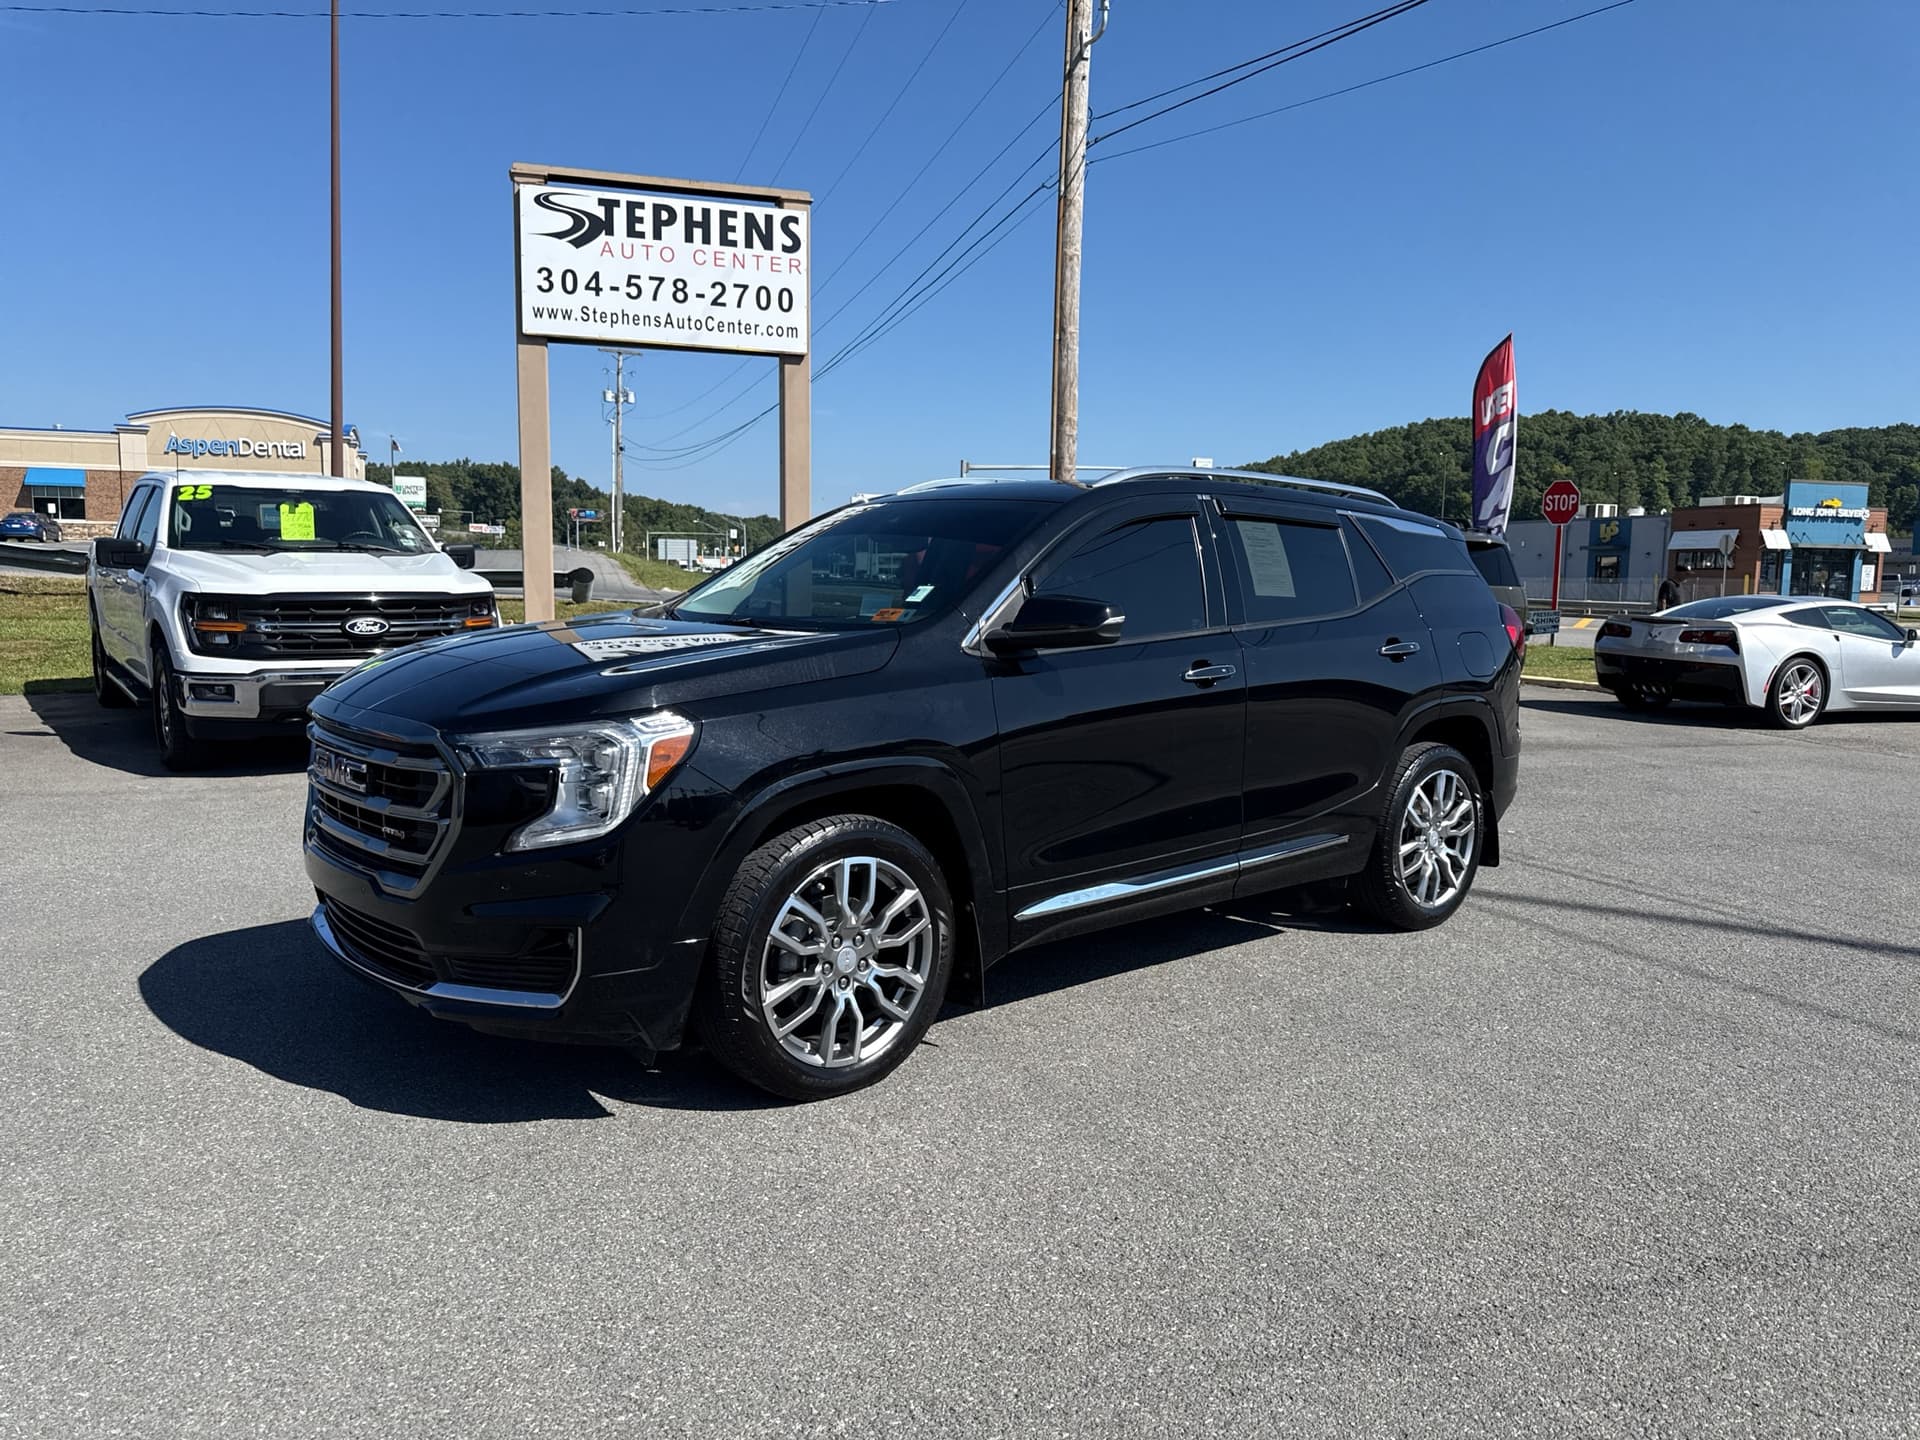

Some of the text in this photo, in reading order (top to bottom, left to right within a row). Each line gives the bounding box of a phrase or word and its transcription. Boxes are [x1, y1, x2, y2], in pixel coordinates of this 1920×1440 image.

[528, 192, 802, 253] STEPHENS
[600, 241, 803, 275] AUTO CENTER
[536, 266, 795, 313] 304-578-2700
[532, 304, 800, 339] www.StephensAutoCenter.com
[178, 484, 213, 501] 25
[1545, 494, 1577, 512] STOP
[1792, 507, 1815, 516] LONG
[1815, 507, 1836, 517] JOHN
[354, 621, 381, 632] Ford
[314, 748, 367, 792] GMC
